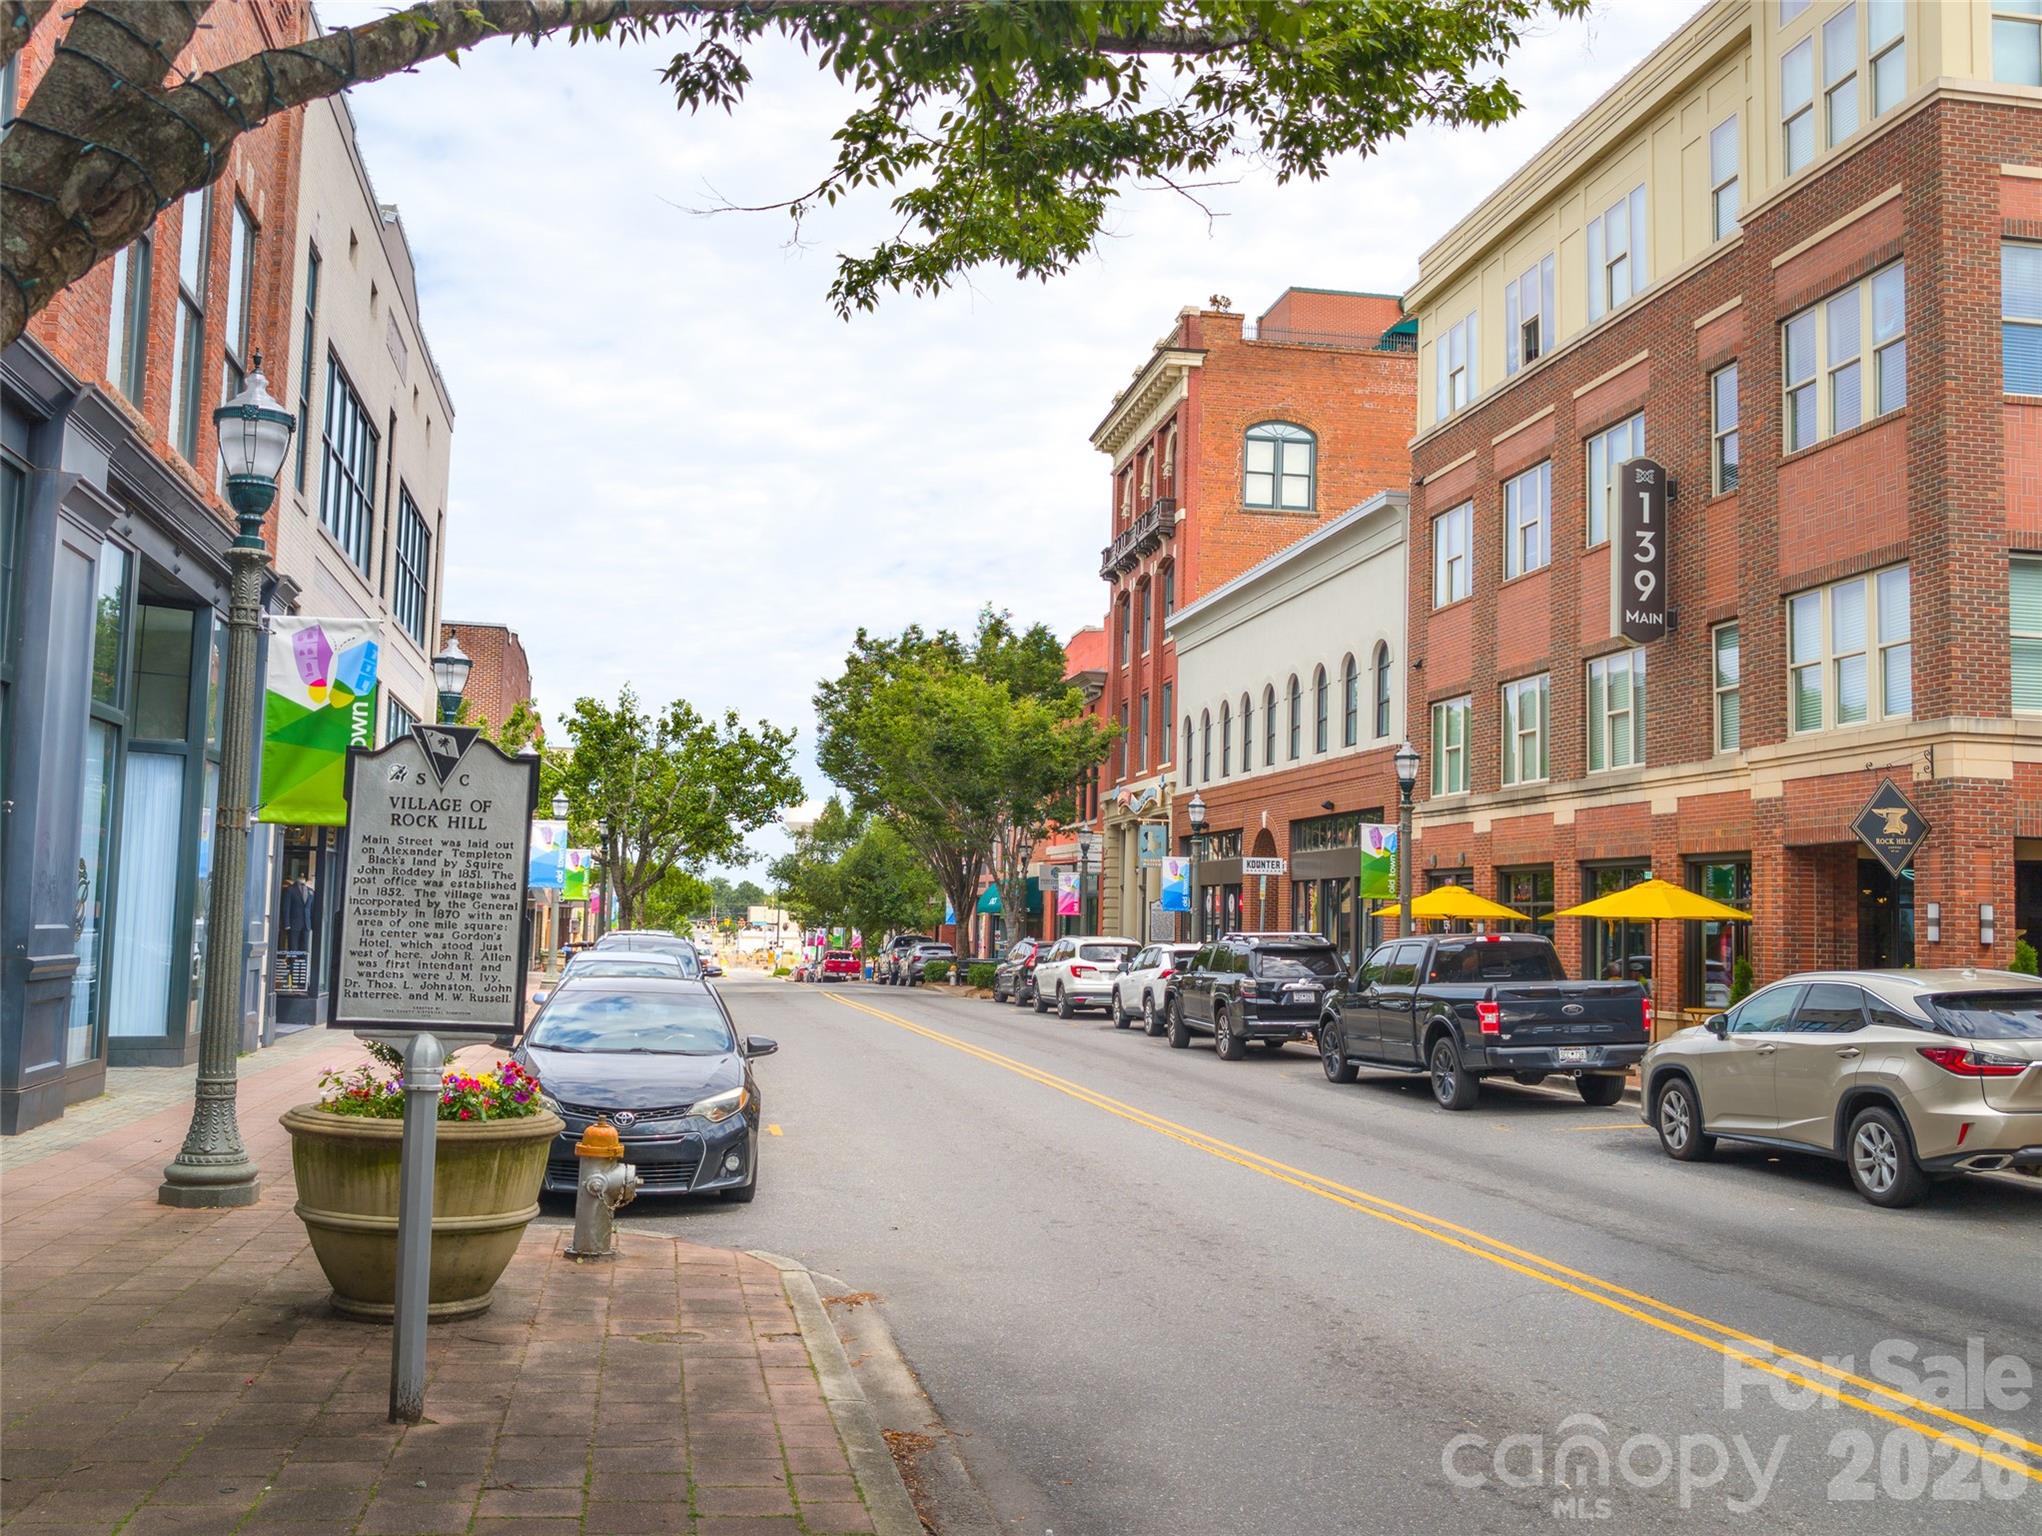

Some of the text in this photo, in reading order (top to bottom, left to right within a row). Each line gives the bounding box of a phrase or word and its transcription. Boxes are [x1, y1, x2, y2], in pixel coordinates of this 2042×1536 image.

[1633, 491, 1656, 602] 139
[351, 701, 369, 746] own
[416, 773, 470, 786] S C
[389, 796, 492, 813] VILLAGE OF
[390, 813, 487, 830] ROCK HILL
[362, 835, 390, 844] Main
[397, 836, 433, 846] Street
[468, 839, 489, 849] laid
[495, 841, 514, 849] out
[1876, 837, 1895, 845] ROCK
[382, 846, 443, 857] Alexander
[452, 848, 512, 860] Templeton
[368, 855, 504, 870] Black's land by Squire
[1246, 860, 1281, 869] KOUNTER
[357, 865, 514, 880] John Roddey in 1851. The
[1388, 854, 1396, 894] old town
[353, 876, 376, 885] post
[384, 876, 417, 886] office
[450, 880, 517, 890] established
[358, 886, 368, 895] in
[376, 887, 404, 897] 1852.
[414, 888, 436, 898] The
[444, 889, 483, 901] village
[349, 896, 518, 911] incorporated by the General
[353, 906, 513, 921] Assembly in 1870 with an
[357, 919, 383, 927] area
[389, 918, 401, 927] of
[408, 920, 429, 928] one
[435, 920, 458, 929] mile
[361, 927, 501, 941] its center was Gordon's
[400, 940, 433, 949] which
[442, 942, 473, 950] stood
[480, 942, 502, 951] just
[377, 949, 389, 958] of
[431, 951, 458, 960] John
[464, 951, 474, 961] R.
[481, 952, 512, 961] Allen
[357, 959, 501, 972] was first intendant and
[357, 970, 404, 978] wardens
[446, 972, 455, 980] J.
[461, 972, 473, 981] M.
[344, 978, 361, 988] Dr.
[367, 979, 396, 989] Thos.
[403, 980, 413, 990] L.
[484, 983, 512, 992] John
[408, 992, 428, 1000] and
[435, 992, 447, 1001] M.
[452, 993, 464, 1001] W.
[469, 993, 512, 1003] Russell.
